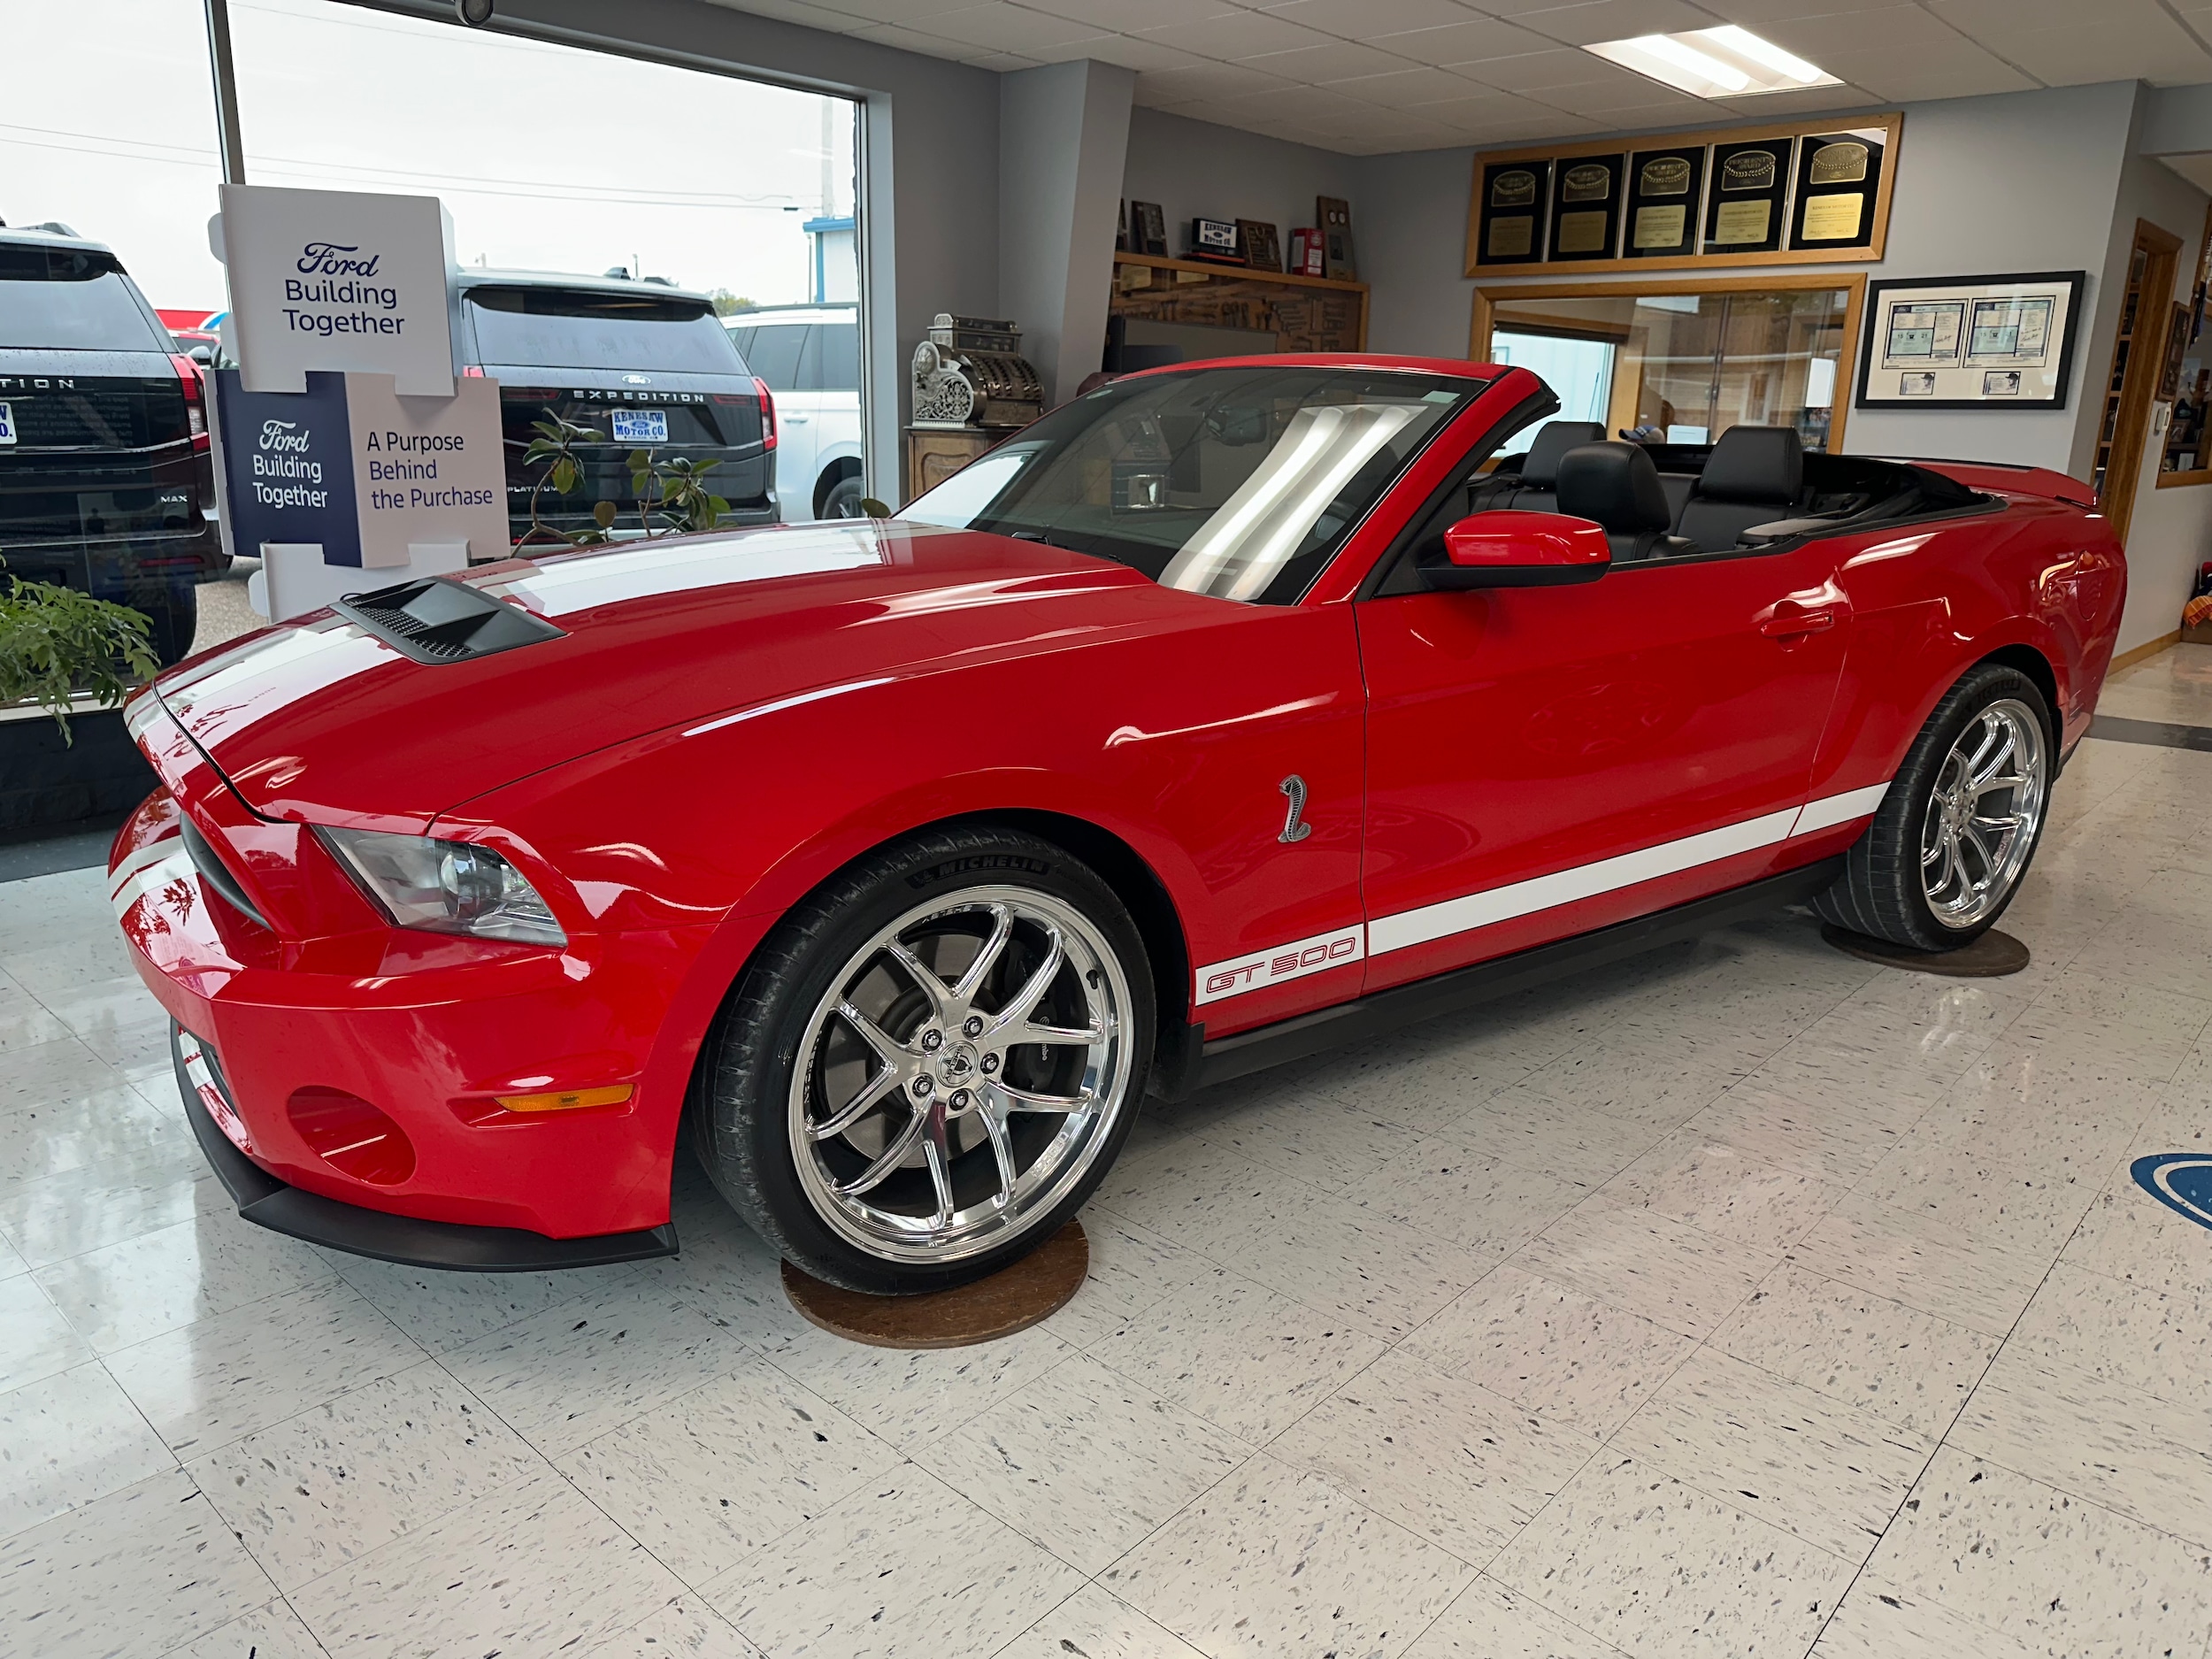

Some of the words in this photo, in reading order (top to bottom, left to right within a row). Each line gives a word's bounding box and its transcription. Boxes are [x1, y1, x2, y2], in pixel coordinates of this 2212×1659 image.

[296, 242, 380, 277] Ford
[285, 280, 397, 310] Building
[282, 309, 405, 337] Together
[573, 390, 704, 403] EXPEDITION
[614, 411, 664, 423] KENESAW
[258, 419, 310, 453] Ford
[615, 425, 650, 436] MOTOR
[652, 426, 666, 436] CO.
[367, 431, 380, 451] A
[386, 431, 464, 455] Purpose
[253, 454, 322, 484] Building
[369, 458, 437, 480] Behind
[160, 495, 188, 503] MAX
[252, 481, 327, 509] Together
[371, 488, 404, 510] the
[411, 486, 493, 508] Purchase
[939, 855, 1045, 877] MICHELIN
[1206, 961, 1265, 995] GT
[1270, 936, 1356, 977] 500
